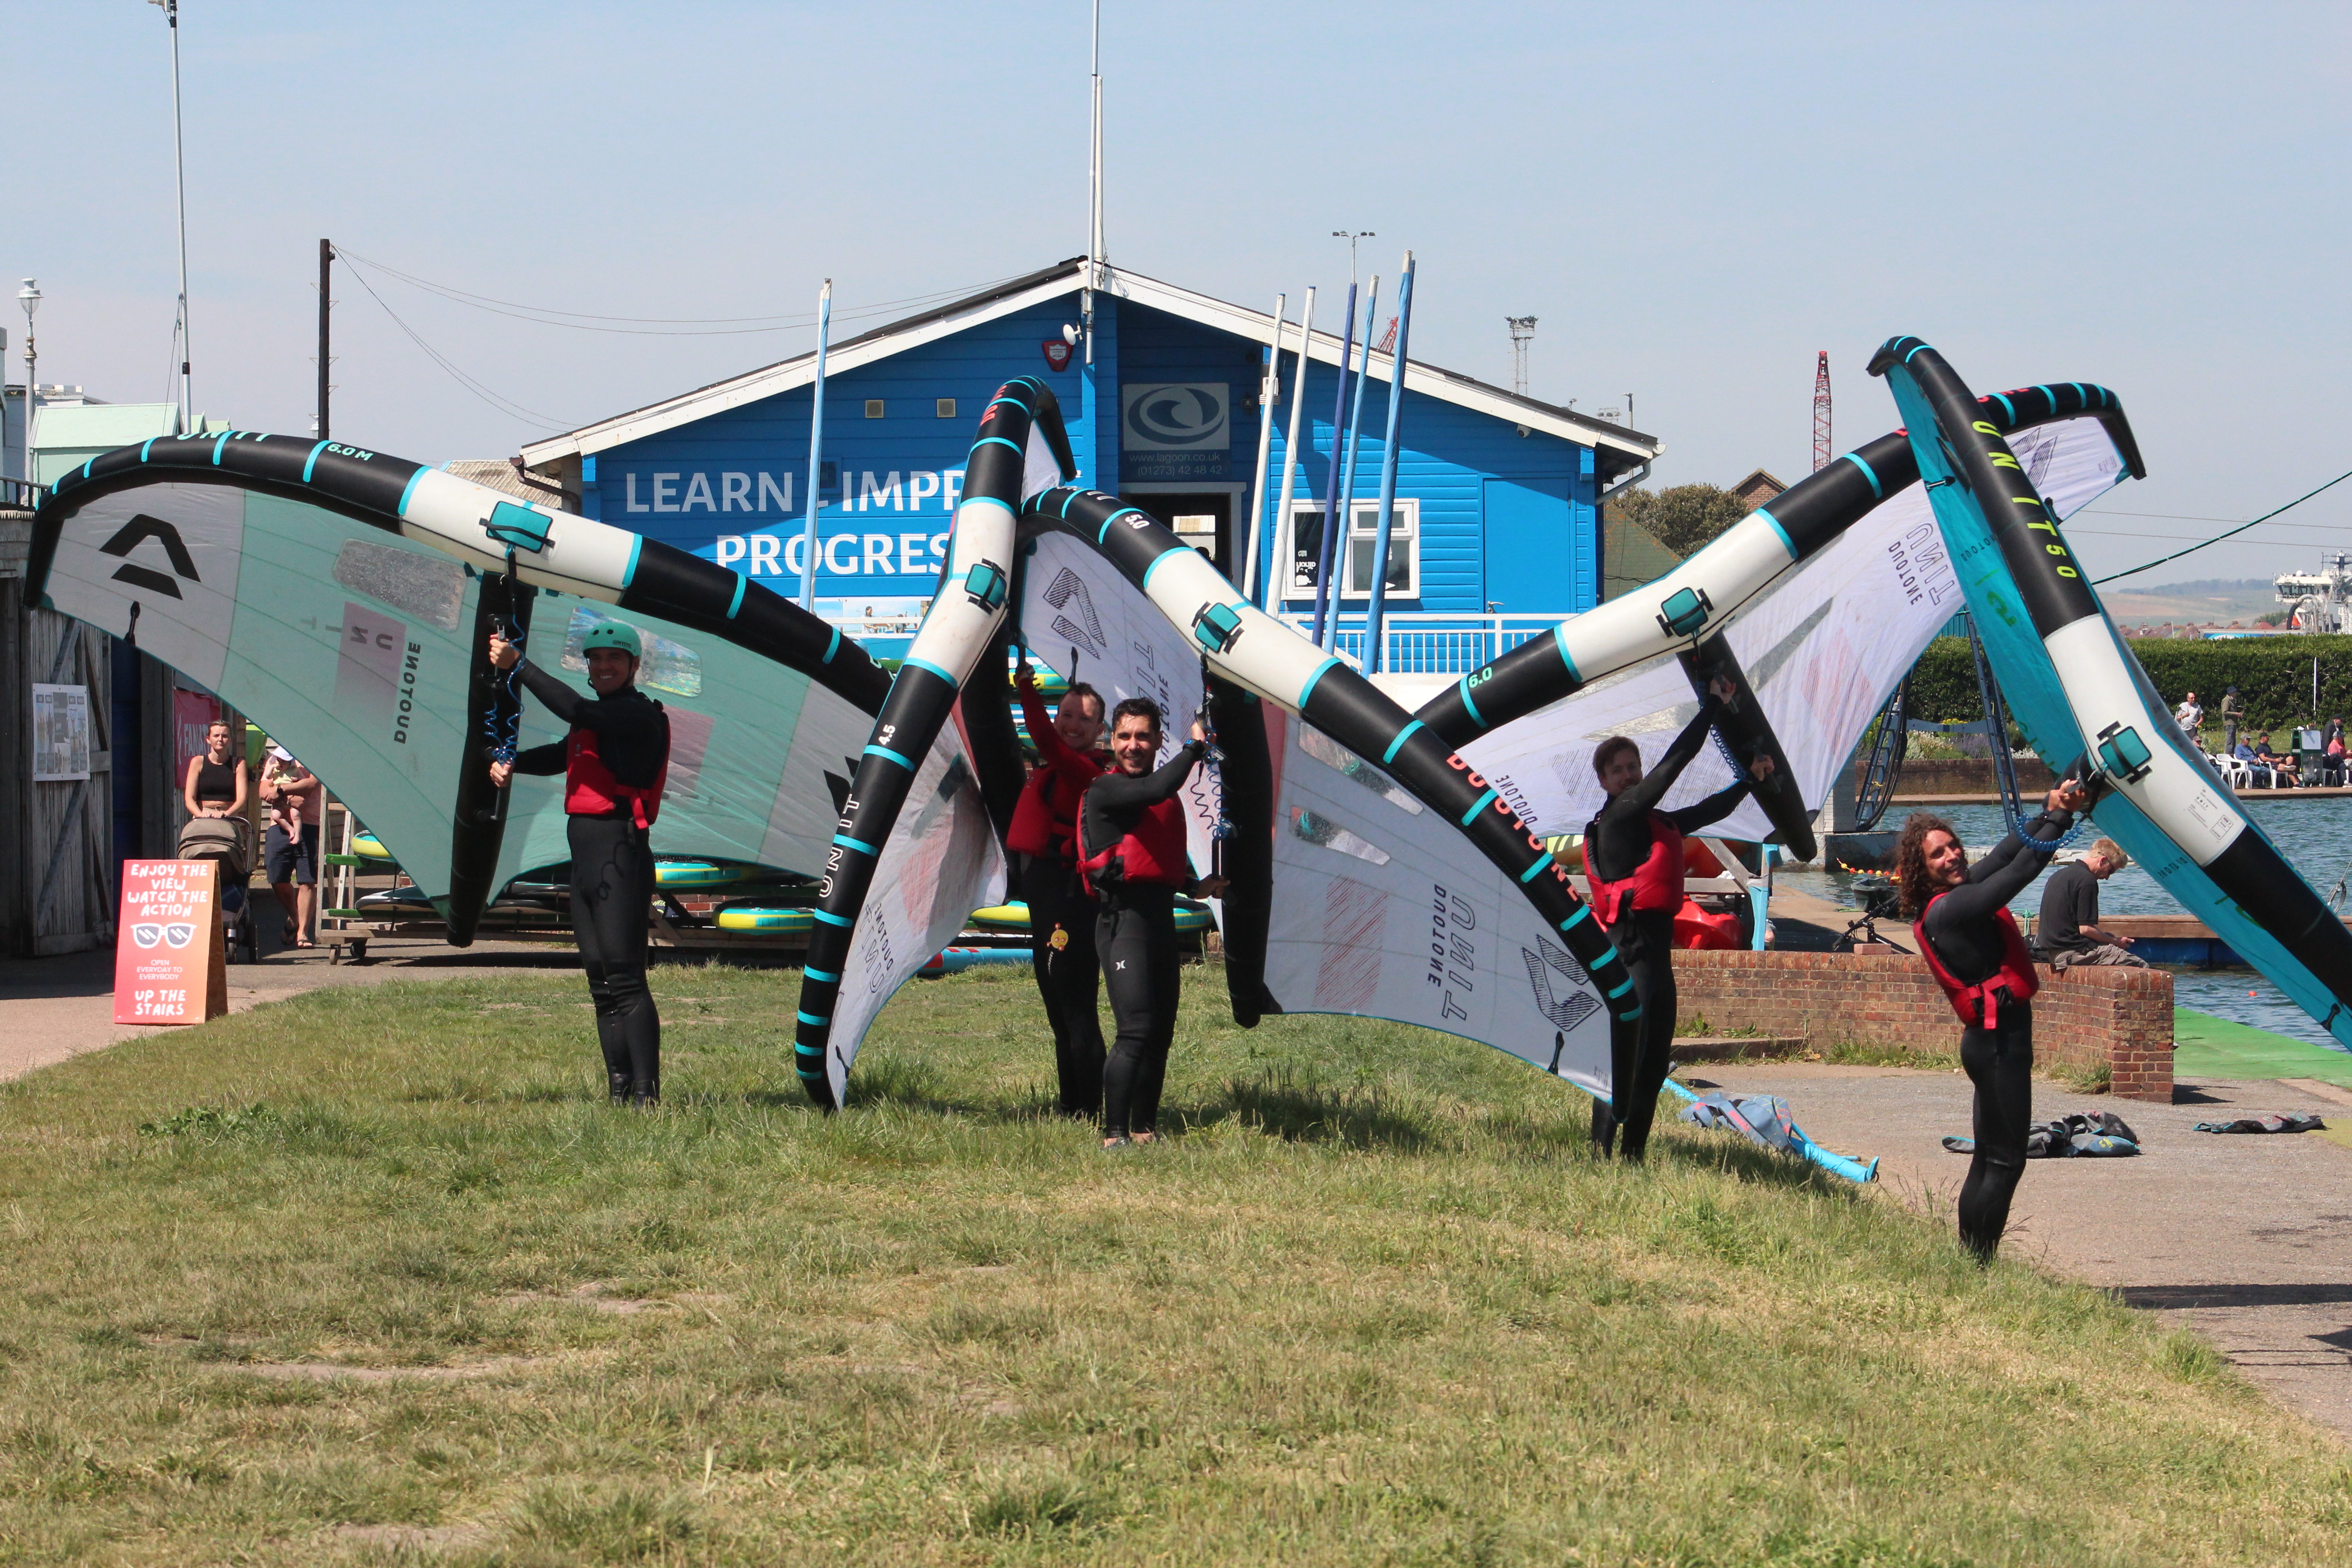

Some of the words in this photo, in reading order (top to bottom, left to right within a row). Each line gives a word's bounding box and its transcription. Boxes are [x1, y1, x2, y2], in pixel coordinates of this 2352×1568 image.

[327, 443, 356, 456] 6.0
[355, 450, 374, 461] M
[1129, 452, 1220, 463] www.lagoon.co.uk
[1138, 466, 1175, 476] (01273)
[1178, 466, 1191, 475] 42
[1194, 466, 1206, 474] 48
[1210, 466, 1222, 474] 42
[1972, 421, 2058, 536] UNIT
[626, 472, 793, 512] LEARN
[1125, 514, 1150, 529] 5.0
[1469, 666, 1493, 688] 6.0
[878, 724, 896, 745] 4.5
[819, 794, 860, 898] UNIT
[131, 864, 176, 878] ENJOY
[182, 864, 208, 877] THE
[151, 877, 186, 890] VIEW
[127, 891, 176, 903] WATCH
[182, 891, 208, 903] THE
[141, 904, 192, 917] ACTION
[135, 990, 154, 1003] UP
[159, 989, 186, 1002] THE
[135, 1003, 184, 1016] STAIRS
